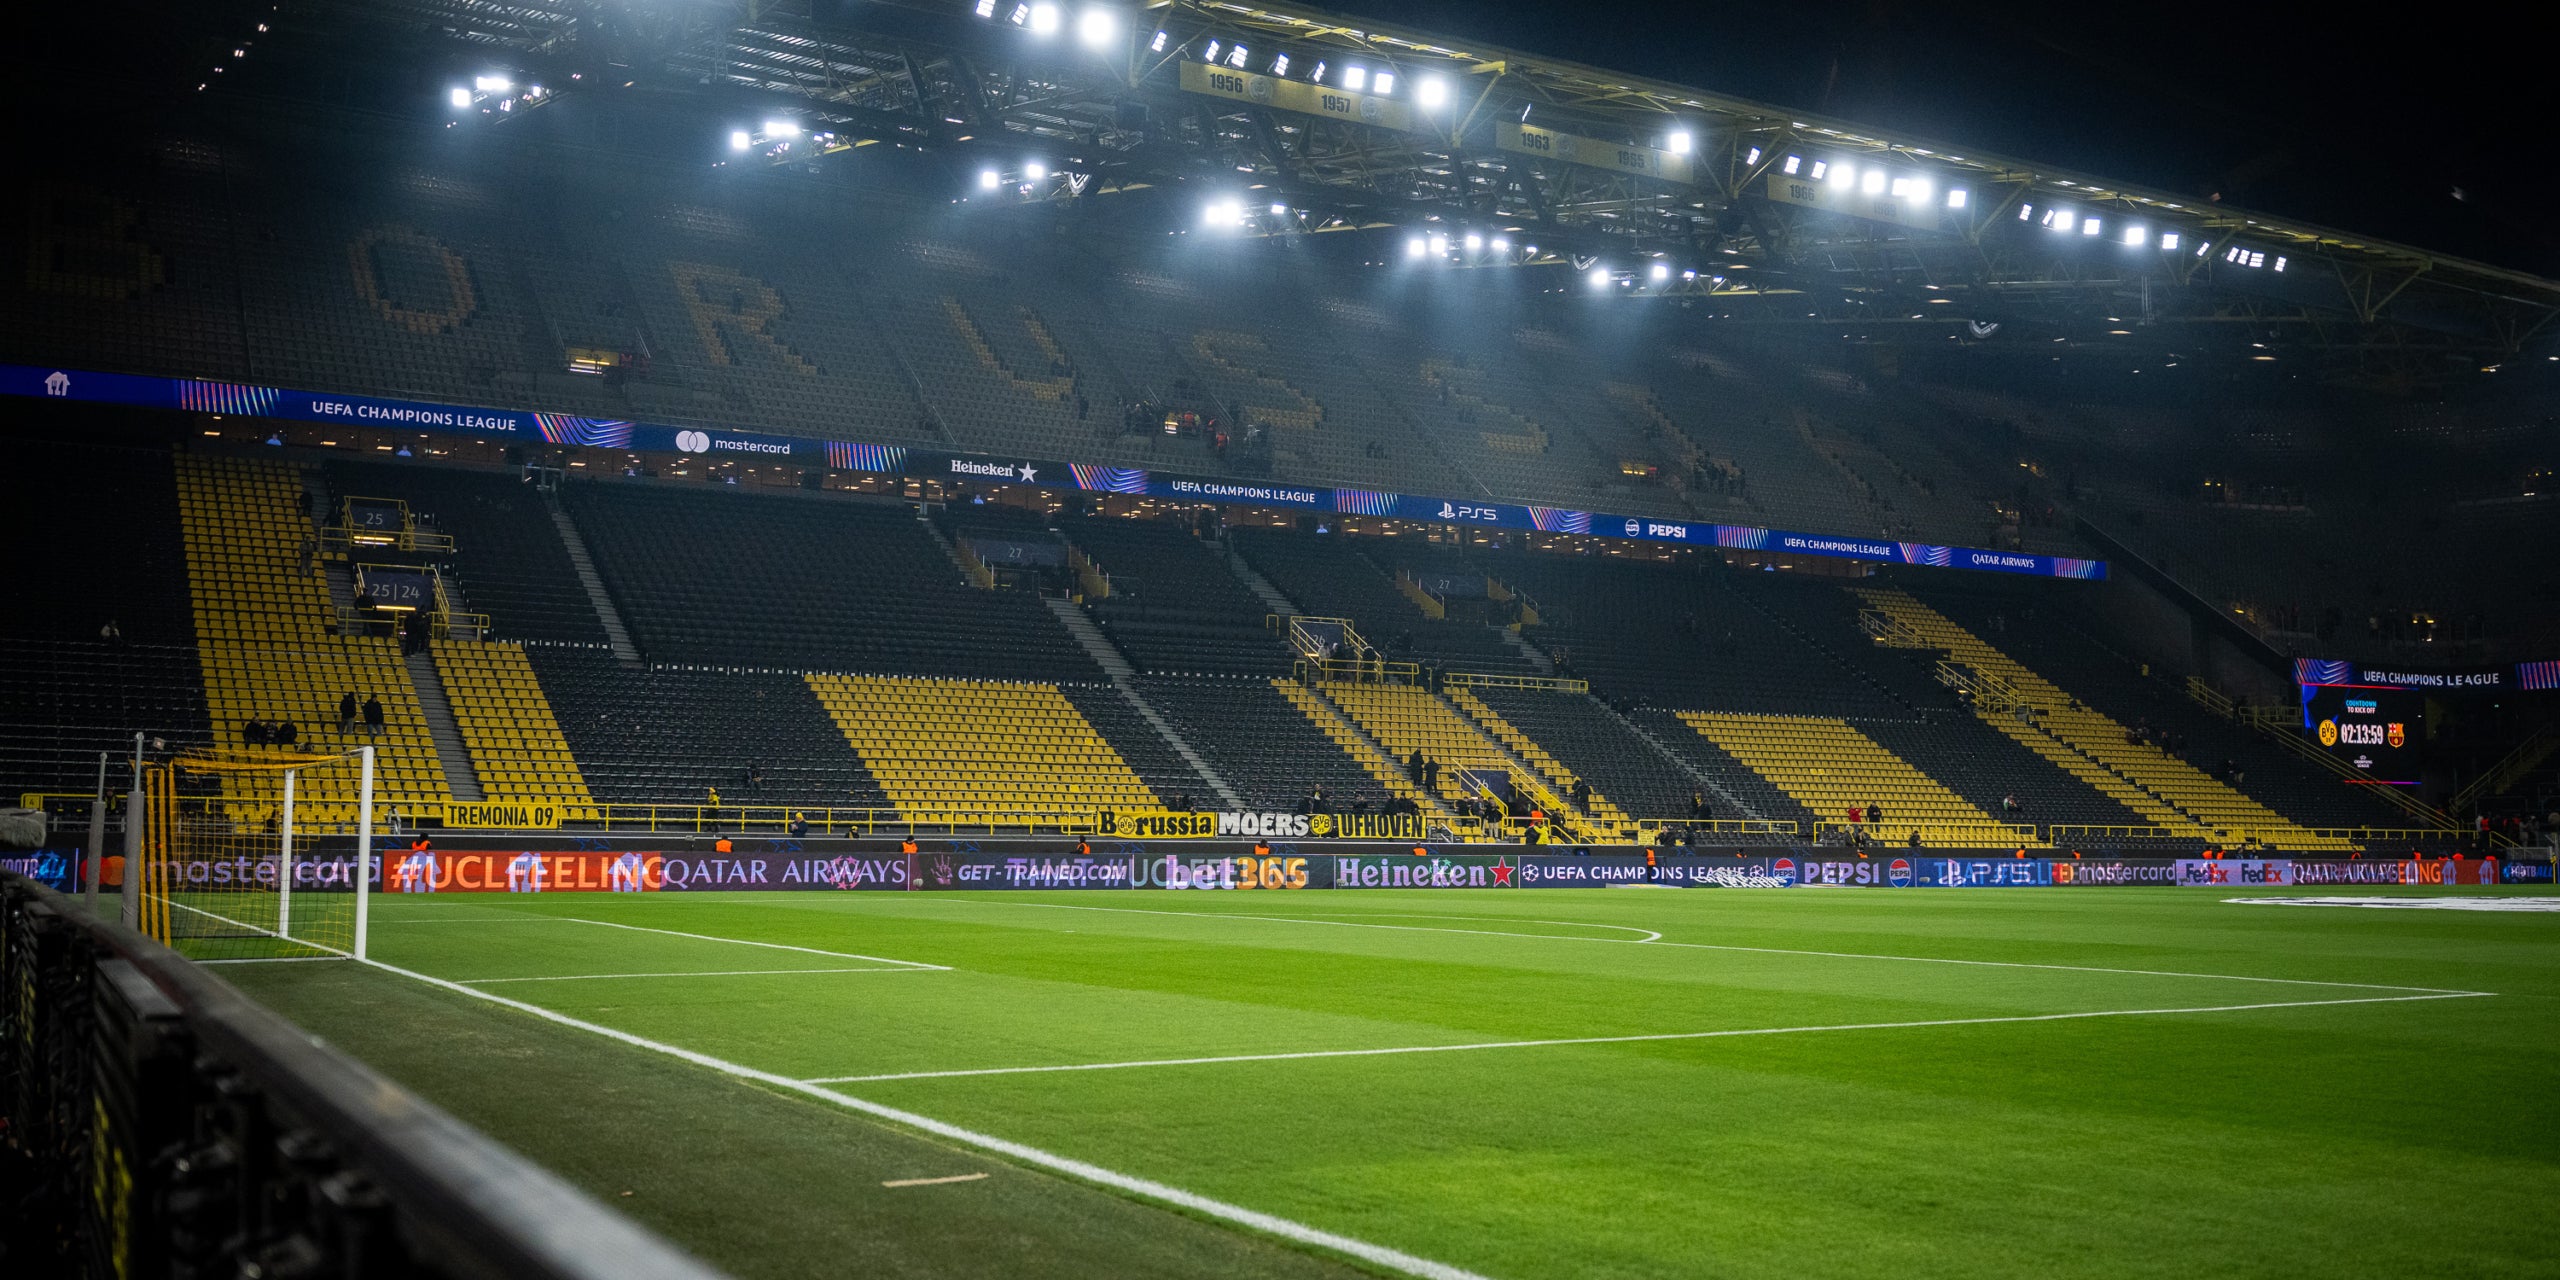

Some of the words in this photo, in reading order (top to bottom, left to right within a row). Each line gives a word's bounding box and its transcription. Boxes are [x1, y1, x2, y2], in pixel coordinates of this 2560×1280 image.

[1210, 73, 1243, 93] 1956
[1321, 94, 1351, 113] 1957
[1521, 131, 1550, 151] 1963
[1789, 184, 1815, 201] 1966
[312, 401, 353, 416] UEFA
[357, 405, 453, 426] CHAMPIONS
[457, 414, 516, 431] LEAGUE
[715, 438, 790, 455] mastercard
[951, 460, 1014, 477] Heineken
[1172, 480, 1201, 493] UEFA
[1204, 484, 1271, 500] CHAMPIONS
[1273, 490, 1315, 503] LEAGUE
[366, 513, 383, 525] 25
[1459, 506, 1497, 520] PS5
[1649, 524, 1686, 538] PEPSI
[1008, 547, 1022, 558] 27
[1784, 537, 1806, 549] UEFA
[1808, 540, 1857, 553] CHAMPIONS
[1859, 544, 1890, 556] LEAGUE
[1972, 553, 2000, 567] QATAR
[2001, 556, 2035, 569] AIRWAYS
[372, 584, 390, 597] 25
[402, 586, 420, 599] 24
[1439, 579, 1450, 590] 27
[2364, 671, 2386, 683] UEFA
[2388, 673, 2443, 686] CHAMPIONS
[2447, 673, 2499, 686] LEAGUE
[2341, 724, 2383, 744] 02:13:59
[448, 806, 530, 827] TREMONIA
[535, 807, 554, 826] 09
[1217, 813, 1310, 837] MOERS
[1341, 814, 1423, 837] UFHOVEN
[391, 856, 670, 888] #UCLFEELING
[664, 858, 768, 889] QATAR
[782, 860, 906, 883] AIRWAYS
[958, 864, 1128, 882] GET-TRAINED.COM
[1166, 855, 1307, 890] bet365
[1339, 857, 1485, 886] Heineken
[1544, 866, 1586, 880] UEFA
[1600, 866, 1683, 880] CHAMPONS
[1804, 862, 1879, 884] PEPSI
[2079, 863, 2175, 881] mastercard
[2186, 863, 2228, 883] FedEx
[2241, 863, 2282, 883] FedEx
